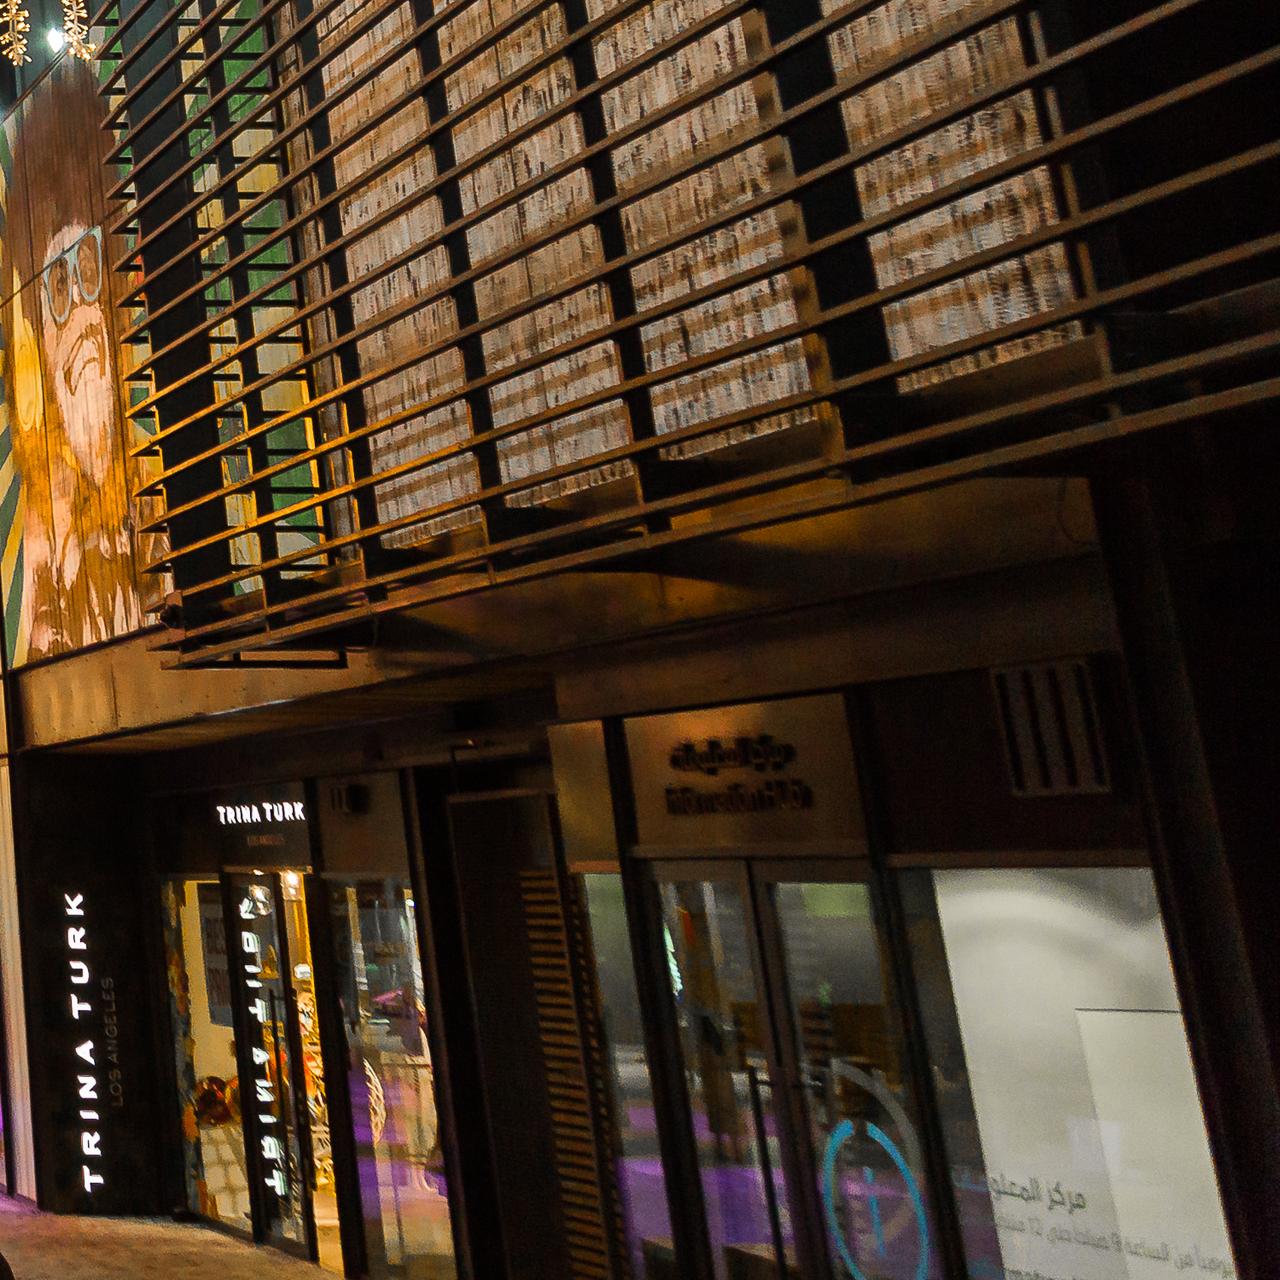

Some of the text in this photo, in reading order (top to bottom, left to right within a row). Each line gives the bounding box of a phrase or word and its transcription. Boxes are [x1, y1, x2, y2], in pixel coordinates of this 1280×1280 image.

[216, 801, 306, 825] TRINA TURK
[64, 892, 105, 1194] TRINA TURK
